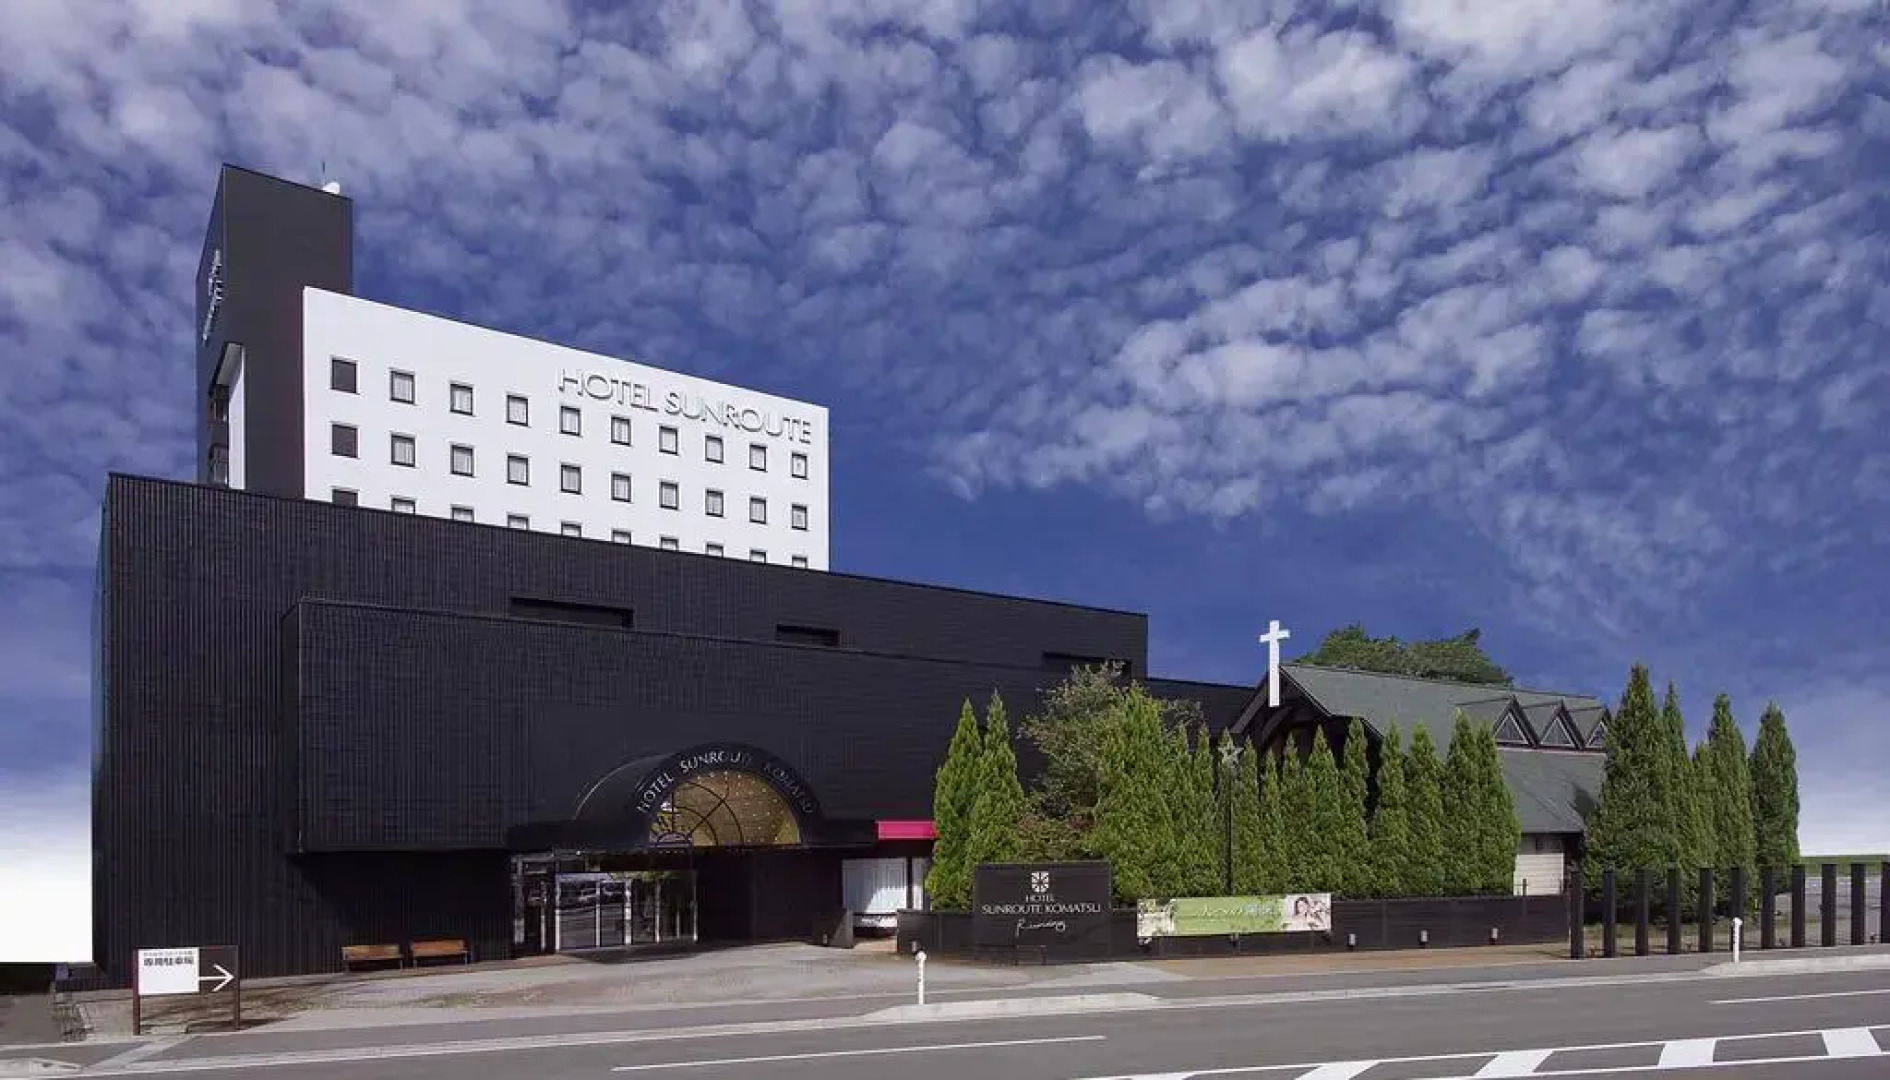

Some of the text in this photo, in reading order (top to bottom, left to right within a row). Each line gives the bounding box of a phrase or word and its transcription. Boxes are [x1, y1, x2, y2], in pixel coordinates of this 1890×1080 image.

[558, 368, 812, 445] HOTEL SUNROUTE
[636, 772, 675, 814] HOTEL
[981, 902, 1101, 915] SUNROUTE KOMATSU
[1025, 894, 1054, 903] HOTEL
